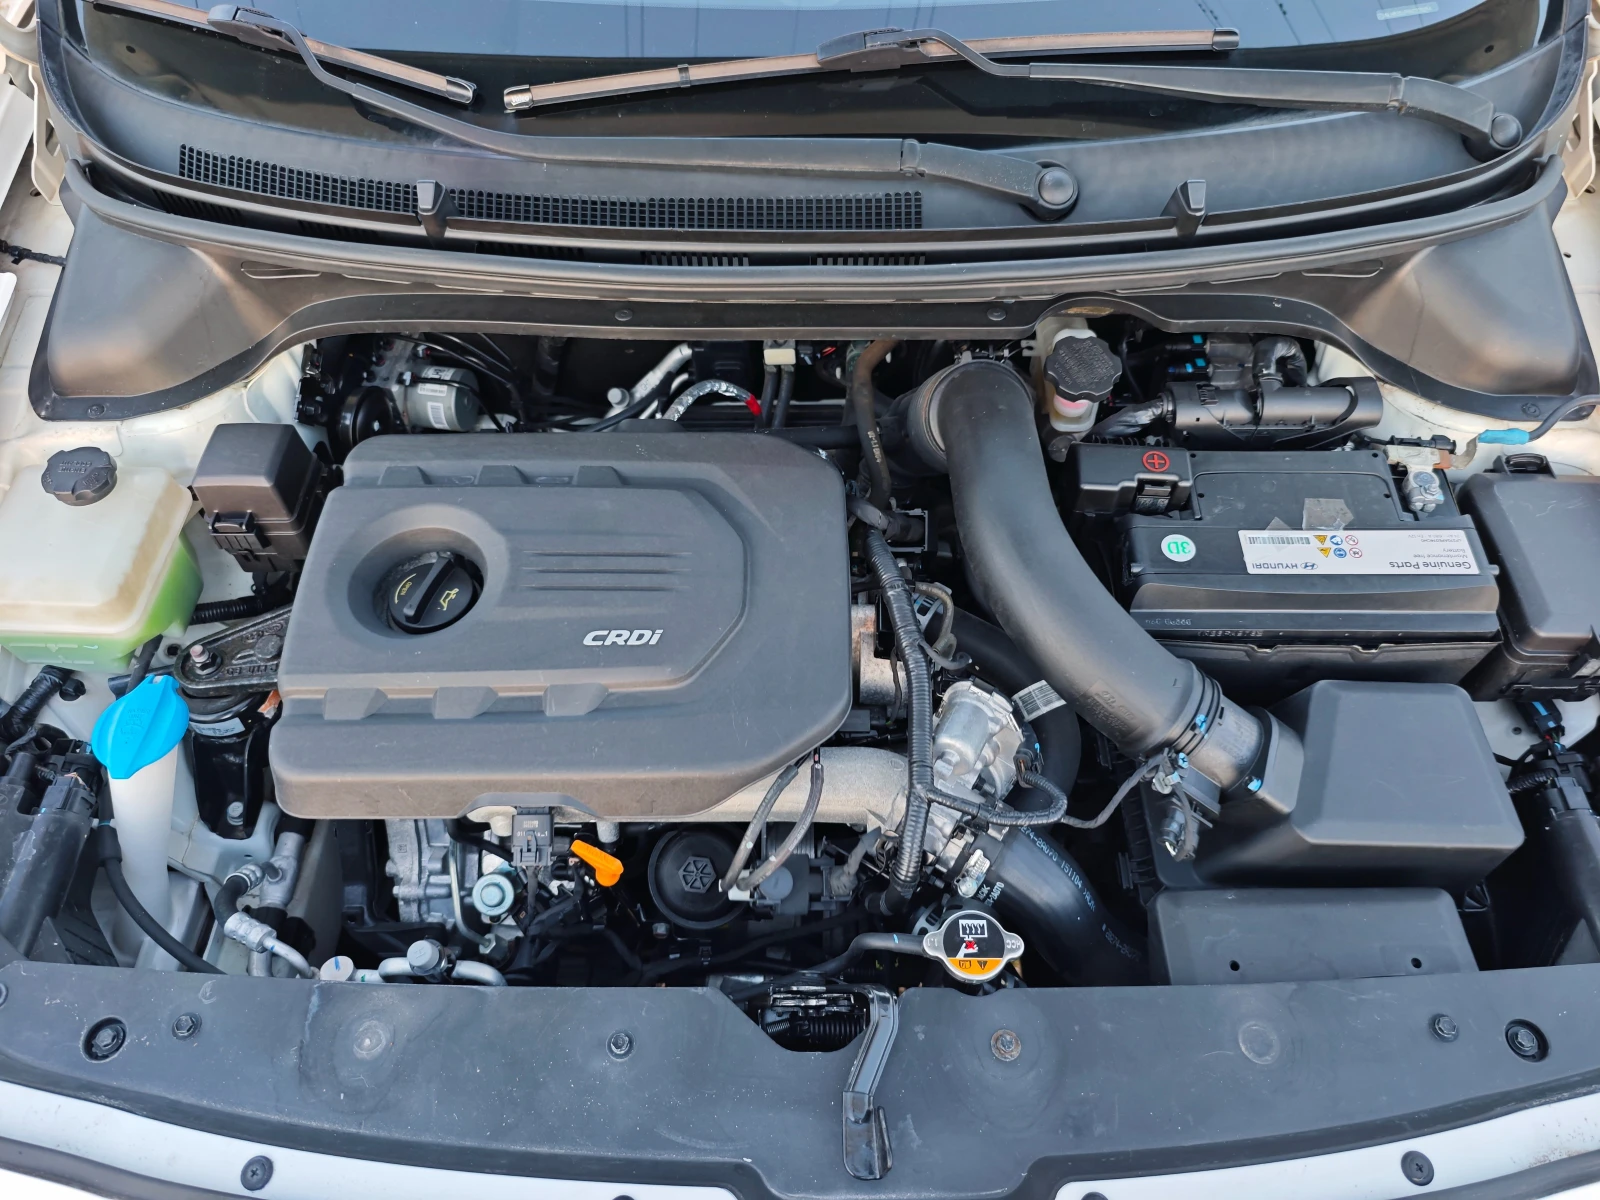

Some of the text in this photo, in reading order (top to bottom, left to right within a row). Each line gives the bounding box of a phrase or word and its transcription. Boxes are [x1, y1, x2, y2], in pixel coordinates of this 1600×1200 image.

[1167, 541, 1191, 555] 3D
[1389, 561, 1472, 570] Genuine Parts
[400, 581, 413, 596] OPEN
[582, 629, 664, 646] CRDi
[1005, 939, 1021, 949] HCC
